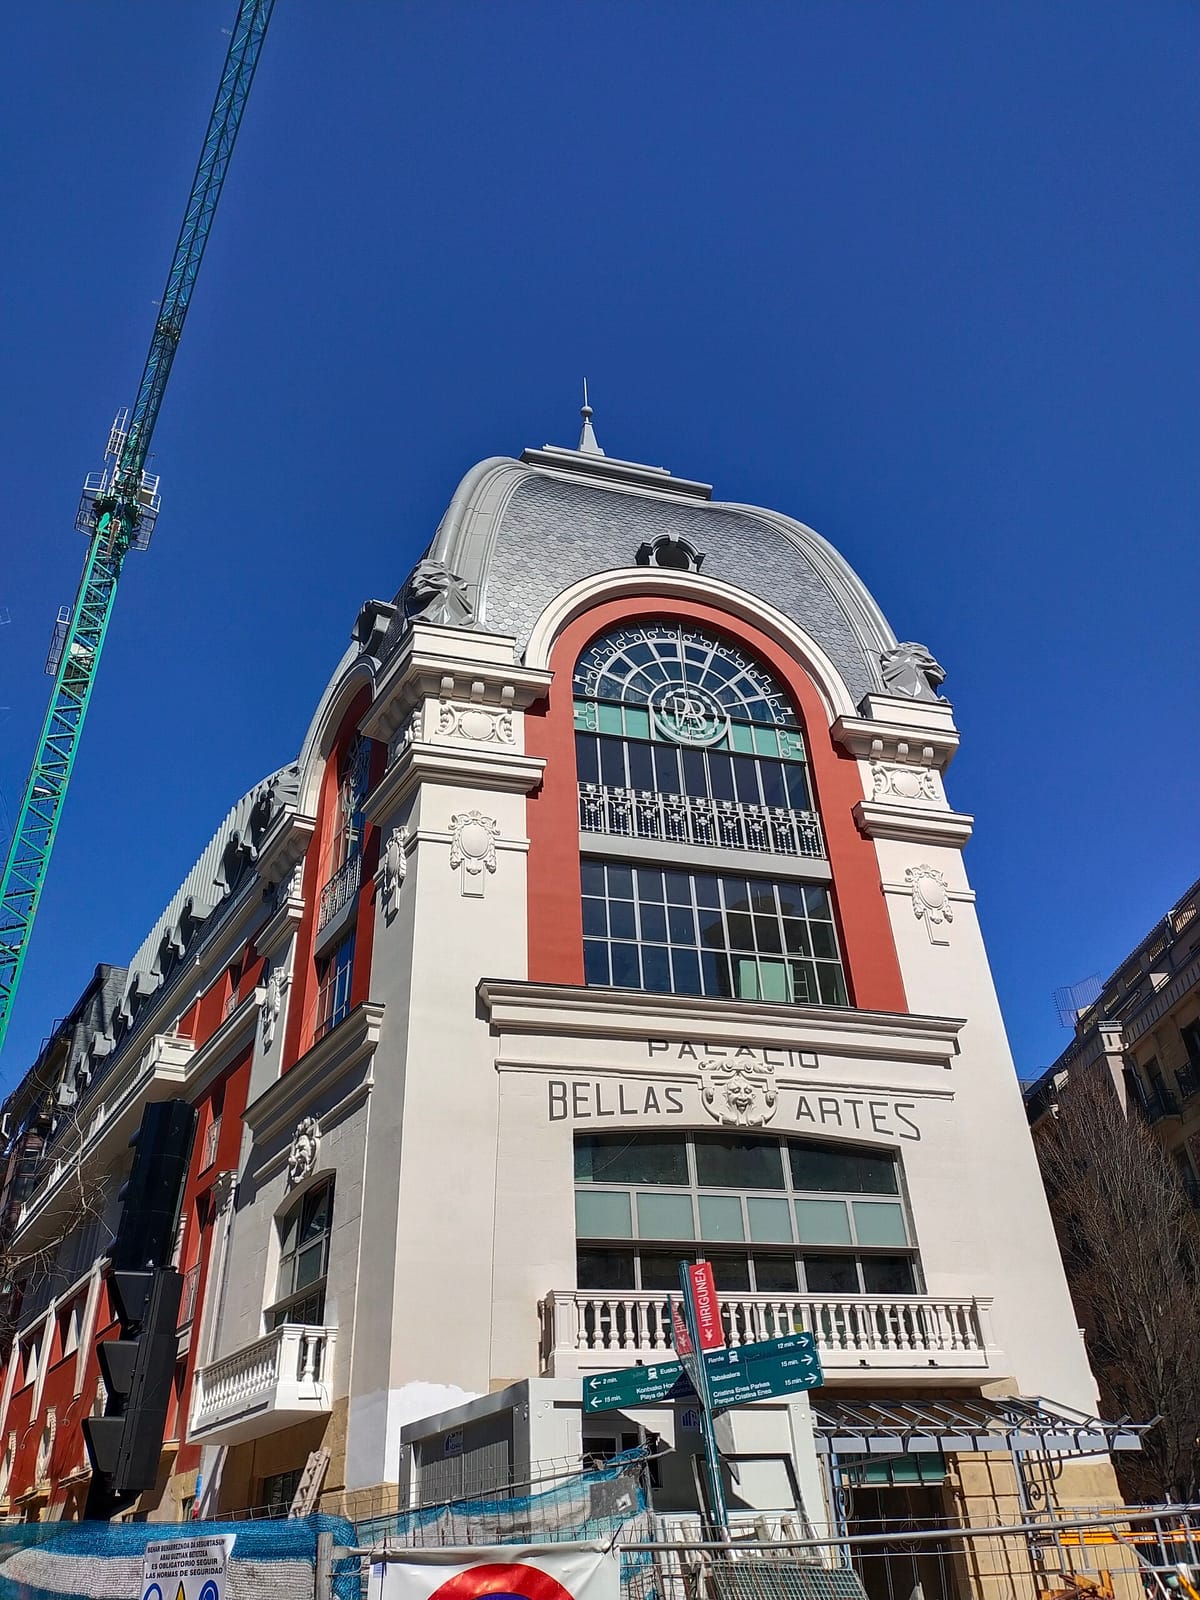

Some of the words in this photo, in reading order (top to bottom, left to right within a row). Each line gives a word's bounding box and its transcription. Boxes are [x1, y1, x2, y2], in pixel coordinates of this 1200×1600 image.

[648, 1039, 819, 1068] PALACIO
[548, 1080, 684, 1121] BELLAS
[795, 1096, 921, 1141] ARTES
[695, 1267, 712, 1327] HIRIGUNEA
[708, 1356, 724, 1364] Renfe
[660, 1367, 677, 1375] Eusko
[710, 1371, 740, 1382] Tabakalera
[713, 1388, 734, 1397] Cristina
[735, 1385, 750, 1393] Enea
[750, 1381, 770, 1390] Parkea
[640, 1393, 656, 1401] Playa
[714, 1396, 734, 1405] Parque
[735, 1392, 756, 1401] Cristina
[159, 1560, 195, 1569] OBLIGATORIO
[196, 1558, 218, 1566] SEGUIR
[190, 1568, 223, 1576] SEGURIDAD
